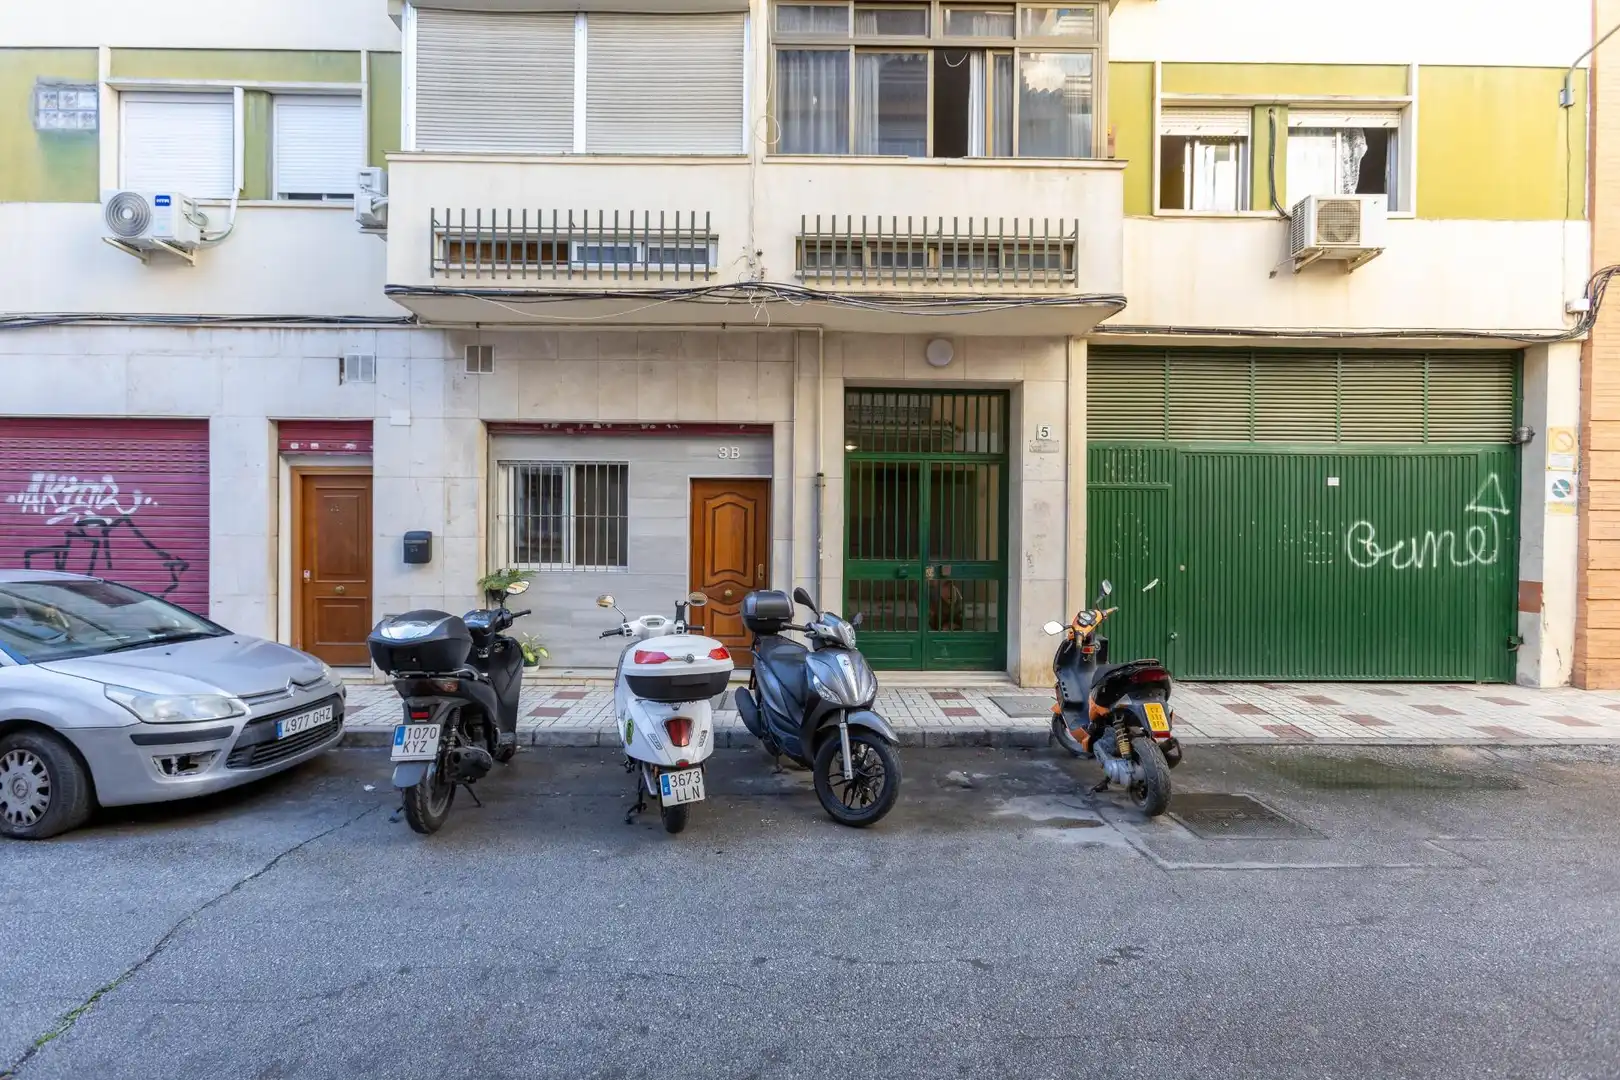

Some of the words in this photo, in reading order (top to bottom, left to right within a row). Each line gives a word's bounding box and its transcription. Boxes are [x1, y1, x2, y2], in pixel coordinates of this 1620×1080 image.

[1040, 426, 1049, 438] 5
[718, 446, 741, 459] 3B
[285, 714, 310, 733] 4977
[313, 707, 331, 724] GHZ
[408, 726, 437, 740] 1070
[402, 740, 427, 753] KYZ
[670, 770, 701, 788] 3673
[676, 785, 700, 802] LLN
